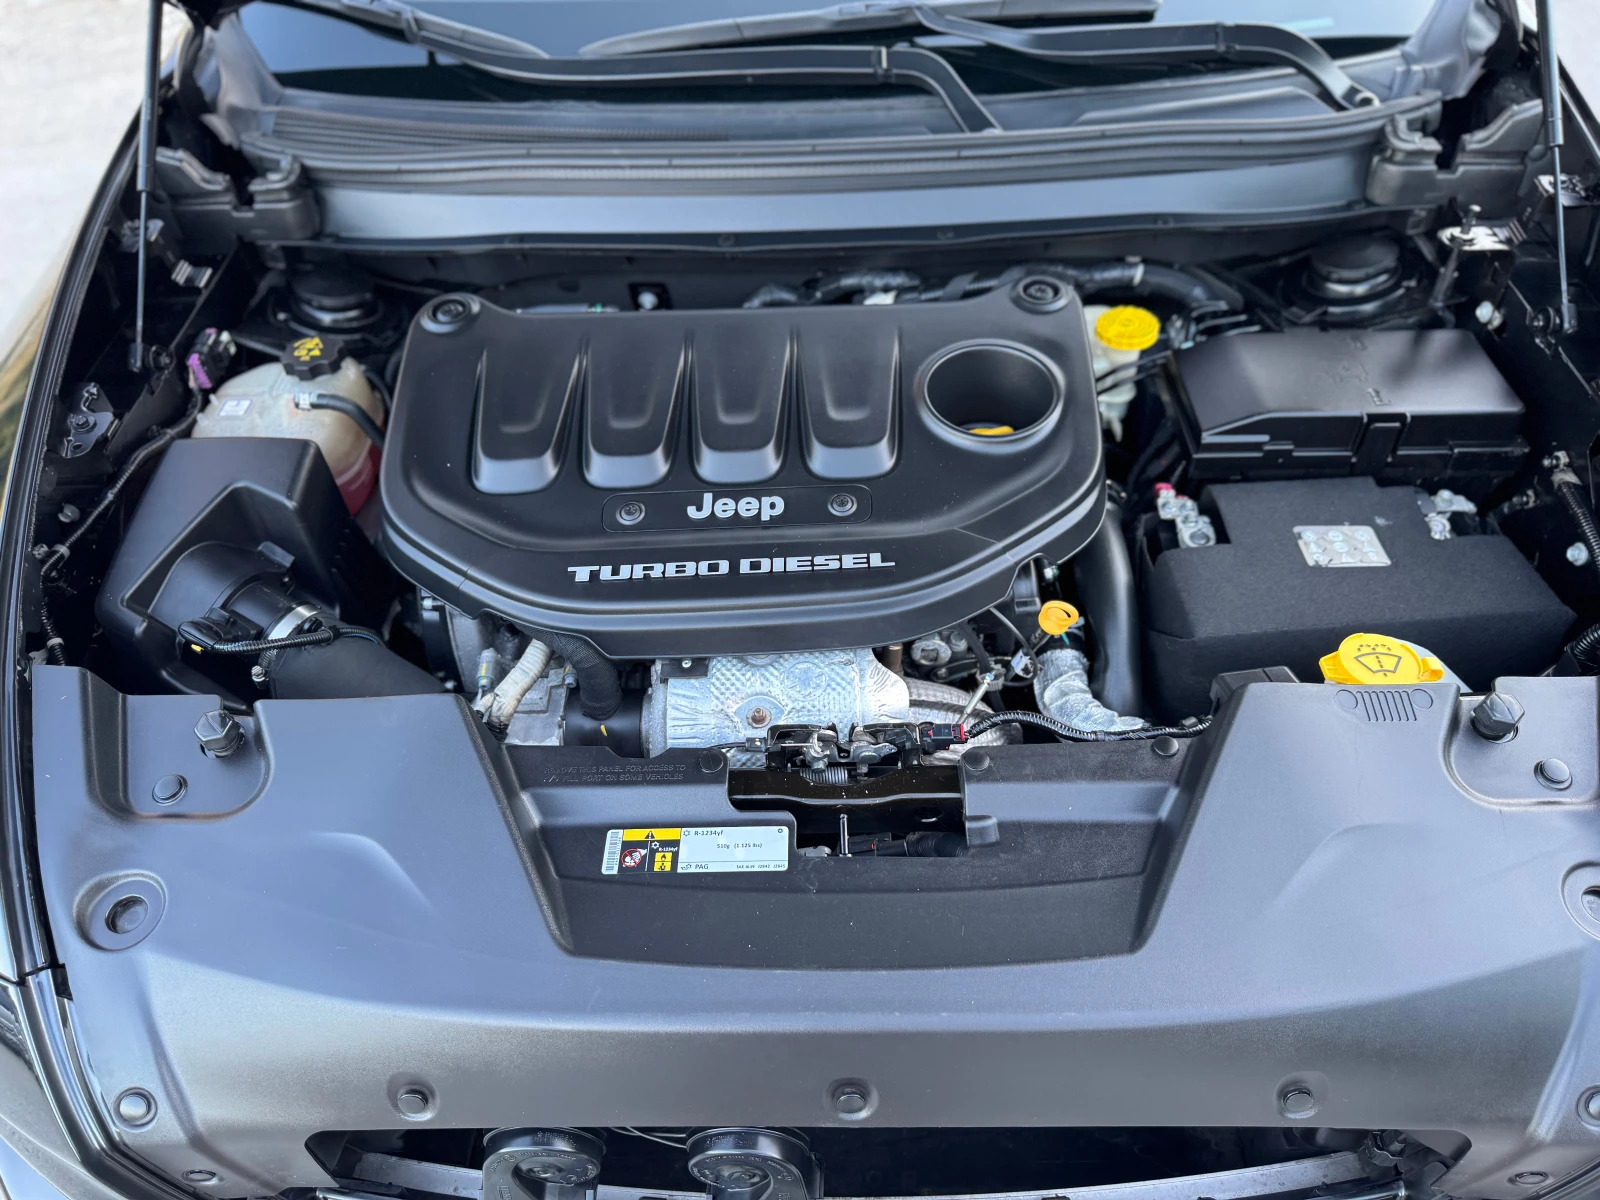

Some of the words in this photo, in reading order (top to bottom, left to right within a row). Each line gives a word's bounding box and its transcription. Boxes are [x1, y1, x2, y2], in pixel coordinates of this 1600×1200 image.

[687, 492, 785, 521] Jeep
[567, 559, 730, 582] TURBO
[739, 552, 896, 575] DIESEL
[598, 765, 624, 773] PANEL
[625, 764, 641, 772] FOR
[642, 763, 674, 772] ACCESS
[581, 774, 603, 782] PORT
[605, 774, 618, 782] ON
[619, 773, 643, 781] SOME
[694, 829, 724, 837] R-1234yf
